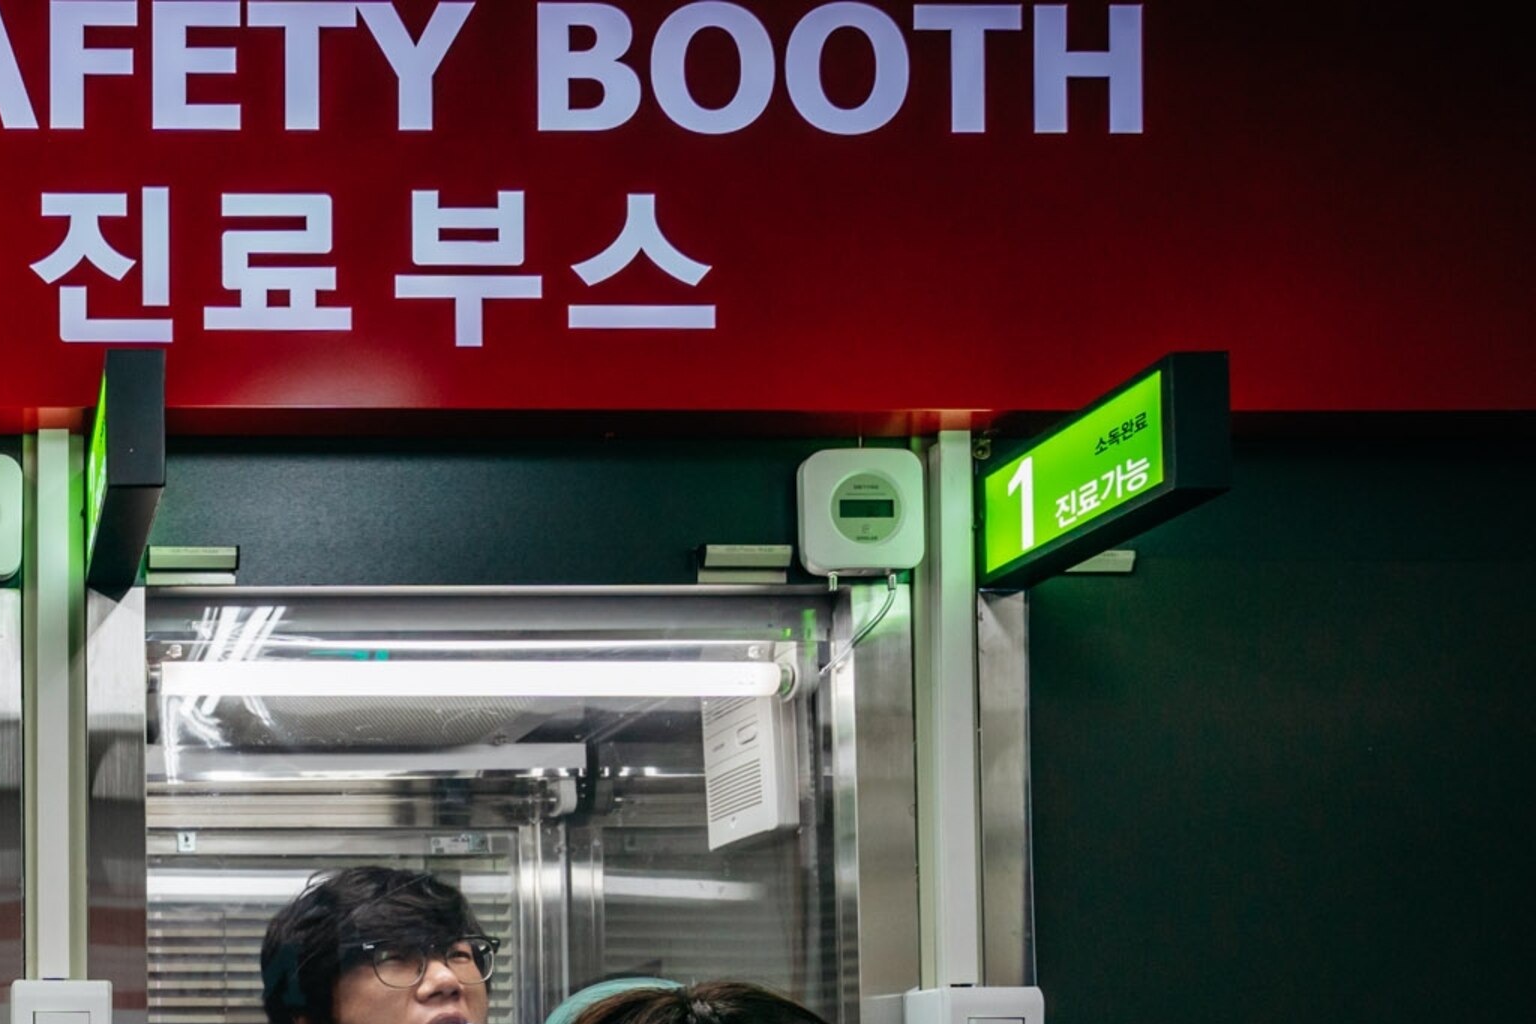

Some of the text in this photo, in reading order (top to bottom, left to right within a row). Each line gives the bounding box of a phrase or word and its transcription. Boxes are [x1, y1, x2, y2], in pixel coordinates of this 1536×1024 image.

[537, 1, 1143, 135] BOOTH
[1094, 411, 1149, 456] 소독완료
[1007, 456, 1034, 550] 1
[1055, 457, 1150, 528] 진료가능
